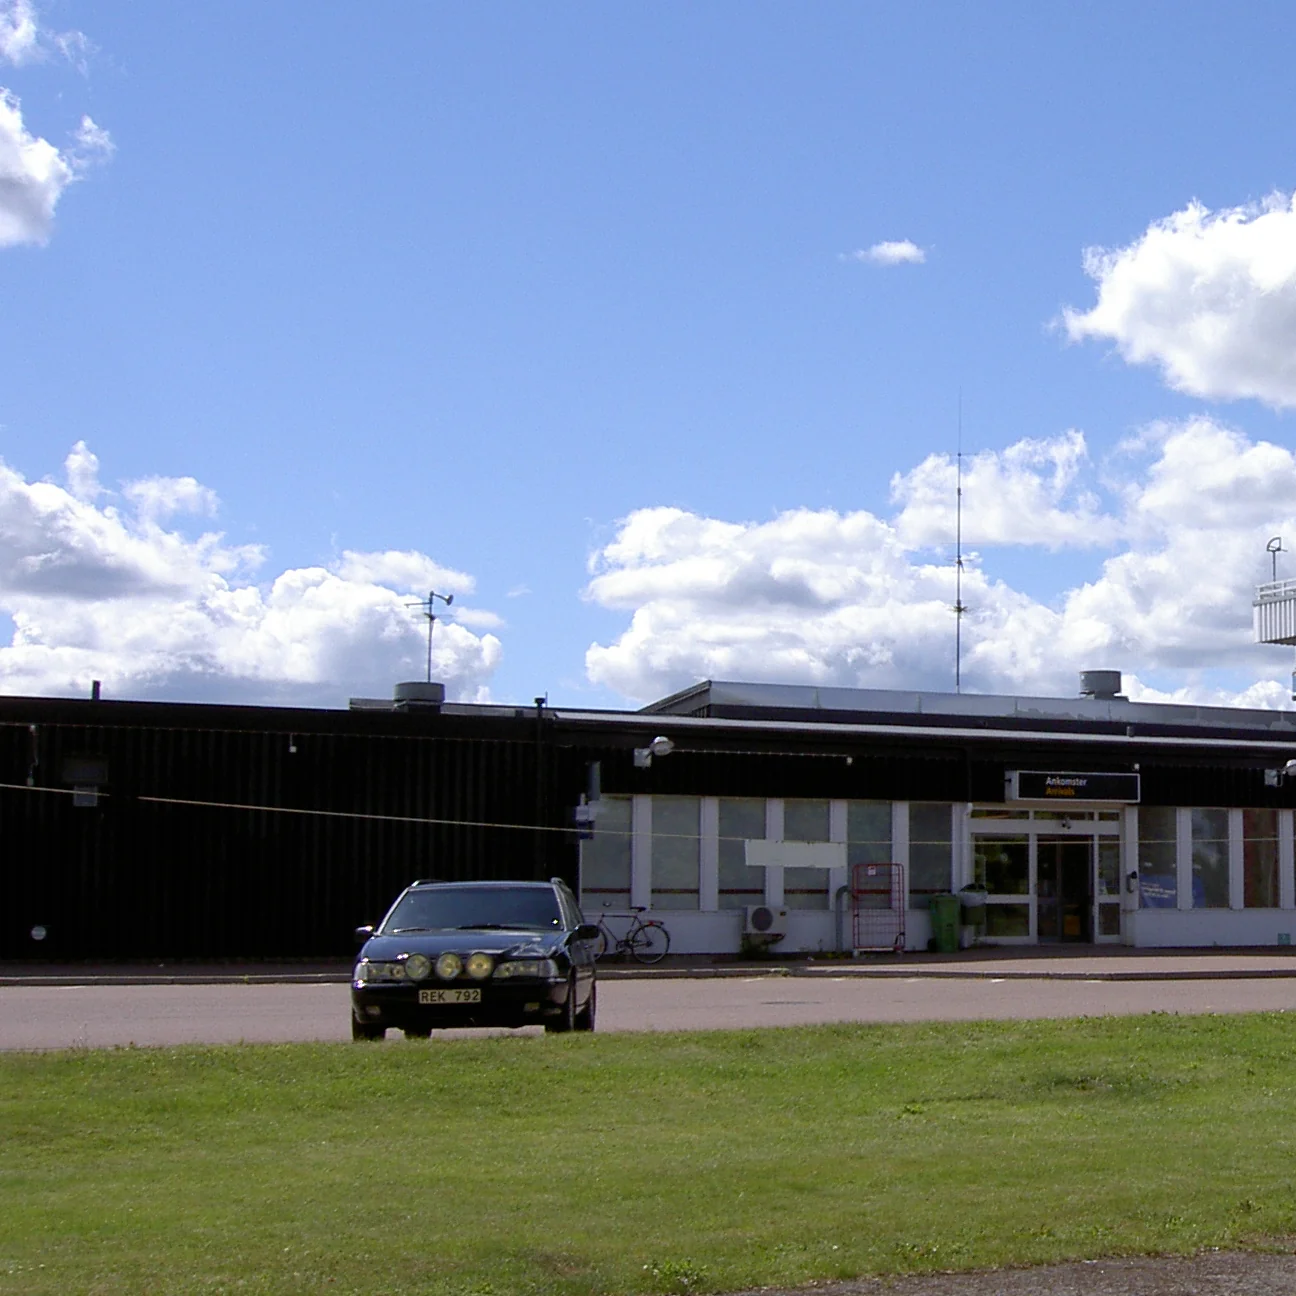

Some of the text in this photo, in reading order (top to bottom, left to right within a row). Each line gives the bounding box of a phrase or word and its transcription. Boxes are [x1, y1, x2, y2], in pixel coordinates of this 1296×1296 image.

[1045, 776, 1088, 786] Ankomster
[421, 990, 479, 1002] REK 792
